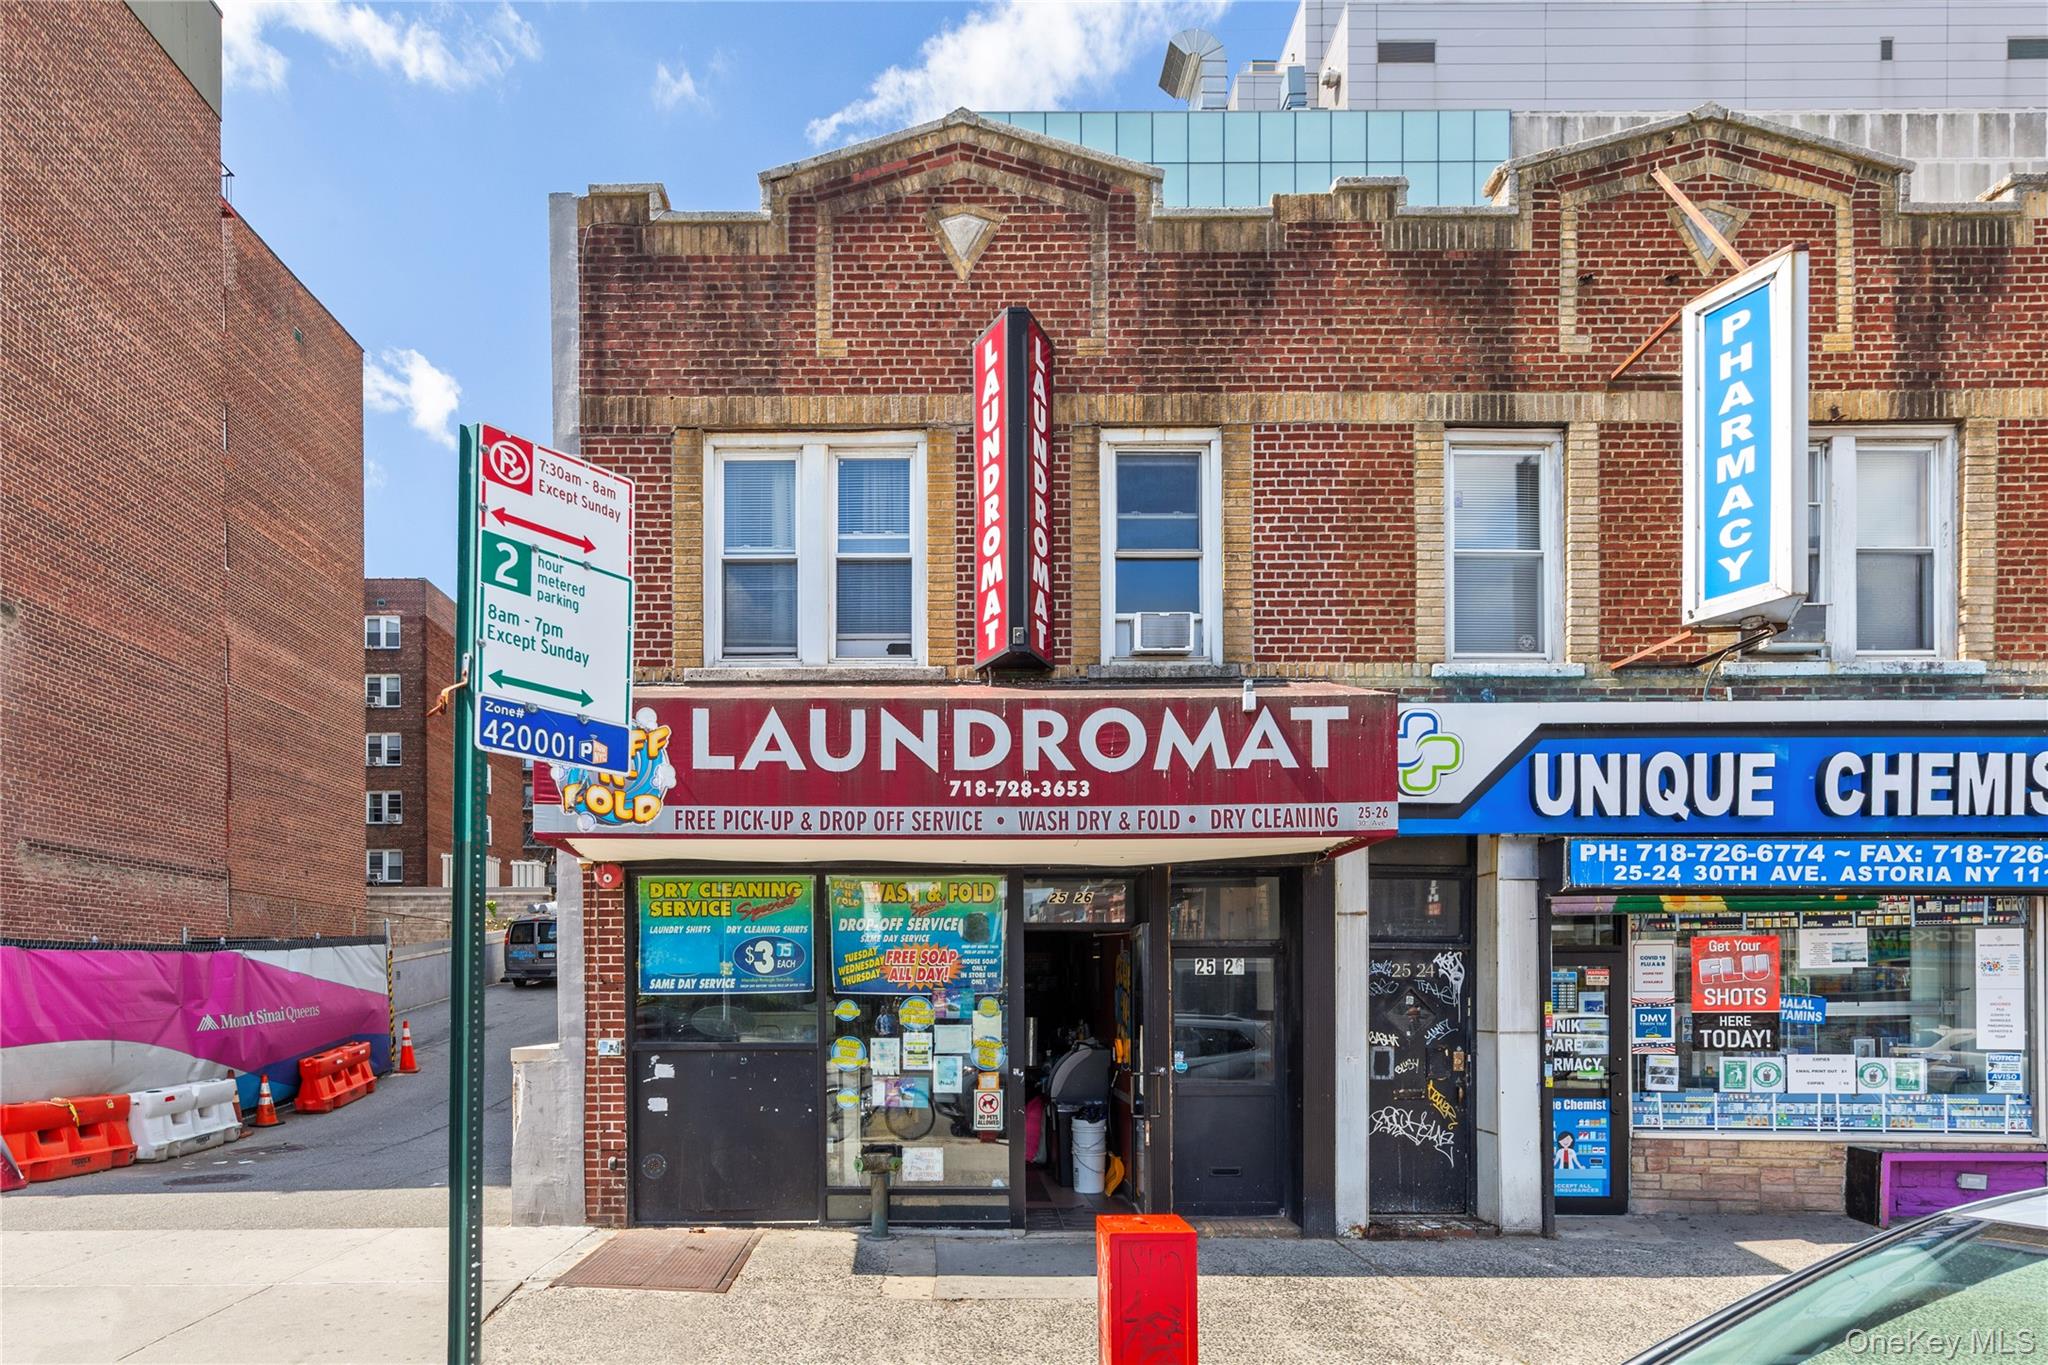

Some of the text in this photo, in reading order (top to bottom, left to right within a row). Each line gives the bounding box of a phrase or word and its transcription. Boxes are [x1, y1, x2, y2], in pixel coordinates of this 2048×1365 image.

[1716, 308, 1756, 583] PHARMACY
[539, 458, 582, 486] 7:30am
[592, 480, 616, 500] 8am
[539, 479, 621, 523] Except Sunday
[980, 338, 1003, 650] LAUNDROMAT
[1033, 336, 1050, 651] LAUNDROMAT
[495, 542, 518, 587] 2
[538, 556, 564, 574] hour
[538, 573, 585, 597] metered
[537, 590, 580, 614] parking
[488, 604, 520, 626] 8am
[535, 616, 563, 638] 7pm
[487, 624, 590, 667] Except Sunday
[485, 700, 525, 718] Zone#
[483, 719, 574, 759] 420001
[692, 705, 1349, 774] LAUNDROMAT
[949, 779, 1090, 798] 718-728-3653
[1534, 750, 1776, 821] UNIQUE
[674, 809, 983, 832] FREE PICK-UP & DROP OFF SERVICE
[1018, 808, 1180, 832] WASH DRY & FOLD
[1211, 806, 1339, 830] DRY CLEANING
[1358, 806, 1389, 819] 25-26
[1580, 844, 1627, 862] PH:
[1637, 844, 1825, 863] 718-726-6774
[1860, 844, 1923, 863] FAX:
[1613, 865, 1681, 881] 25-24
[1693, 865, 1757, 881] 30TH
[1770, 865, 1827, 881] AVE.
[1840, 866, 1951, 882] ASTORIA
[1965, 866, 2000, 882] NY
[649, 881, 803, 899] DRY CLEANING
[948, 882, 996, 903] FOLD
[1049, 892, 1093, 904] 25 26
[649, 900, 732, 917] SERVICE
[650, 925, 711, 934] LAUNDRY SHIRTS
[726, 925, 808, 934] DRY CLEANING SHIRTS
[906, 918, 959, 931] SERVICE
[860, 934, 930, 943] SAME DAY SERVICE
[1708, 939, 1761, 952] Get Your
[844, 946, 878, 963] TUESDAY
[885, 948, 958, 965] FREE SOAP
[776, 960, 796, 968] EACH
[837, 955, 885, 976] WEDNESDAY
[1195, 959, 1216, 975] 25
[1391, 963, 1436, 978] 25 24
[1698, 953, 1770, 985] FLU
[841, 968, 881, 986] THURSDAY
[887, 966, 950, 982] ALL DAY!
[649, 979, 676, 989] SAME
[677, 979, 697, 989] DAY
[699, 978, 736, 989] SERVICE
[1704, 987, 1767, 1006] SHOTS
[1780, 997, 1815, 1010] HALAL
[256, 1006, 285, 1024] Sinai
[285, 1005, 321, 1023] Queens
[1639, 1013, 1667, 1022] DMV
[1719, 1015, 1752, 1027] HERE
[1700, 1029, 1771, 1049] TODAY!
[1563, 1099, 1607, 1111] Chemist
